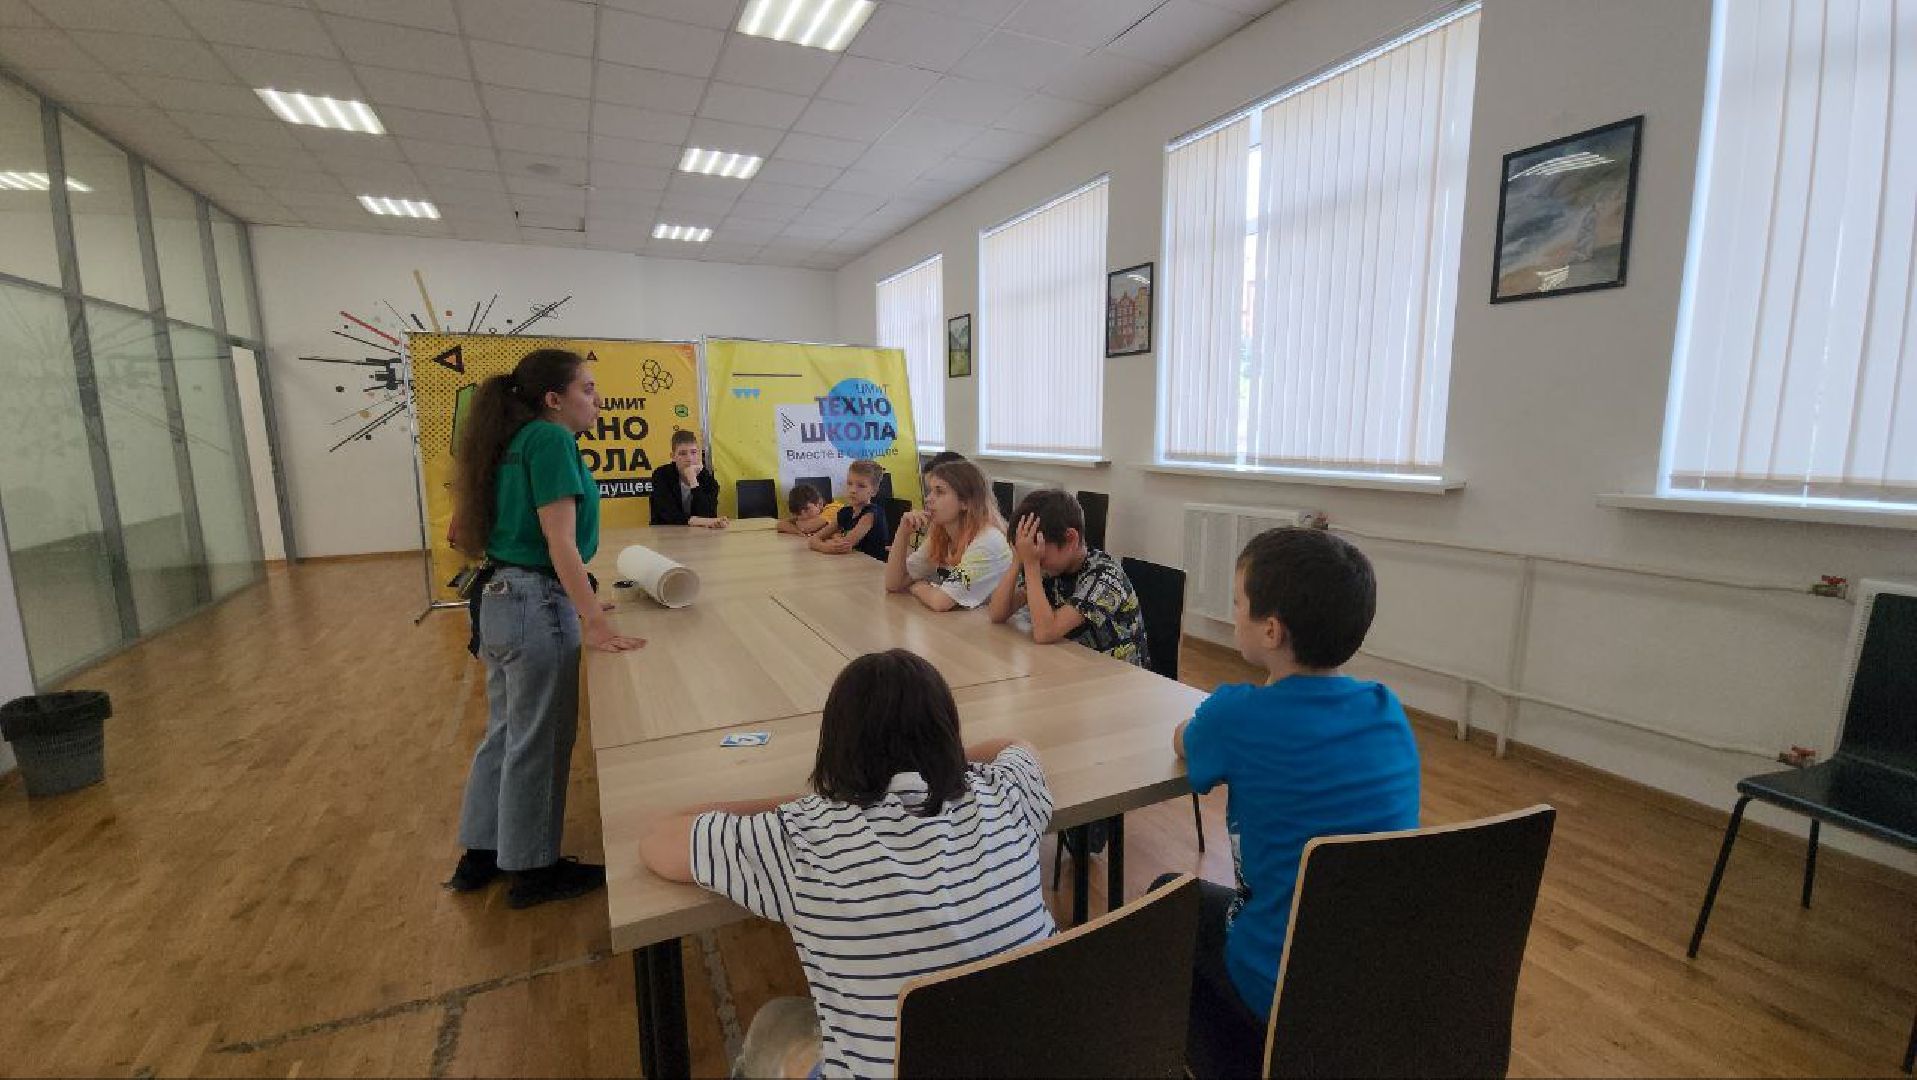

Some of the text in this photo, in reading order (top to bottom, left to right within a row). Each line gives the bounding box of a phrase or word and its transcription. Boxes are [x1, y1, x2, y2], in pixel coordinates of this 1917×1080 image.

[599, 397, 646, 411] ЦМИТ
[814, 395, 892, 416] ТЕХНО
[800, 421, 897, 443] ШКОЛА
[786, 449, 835, 461] Вместе
